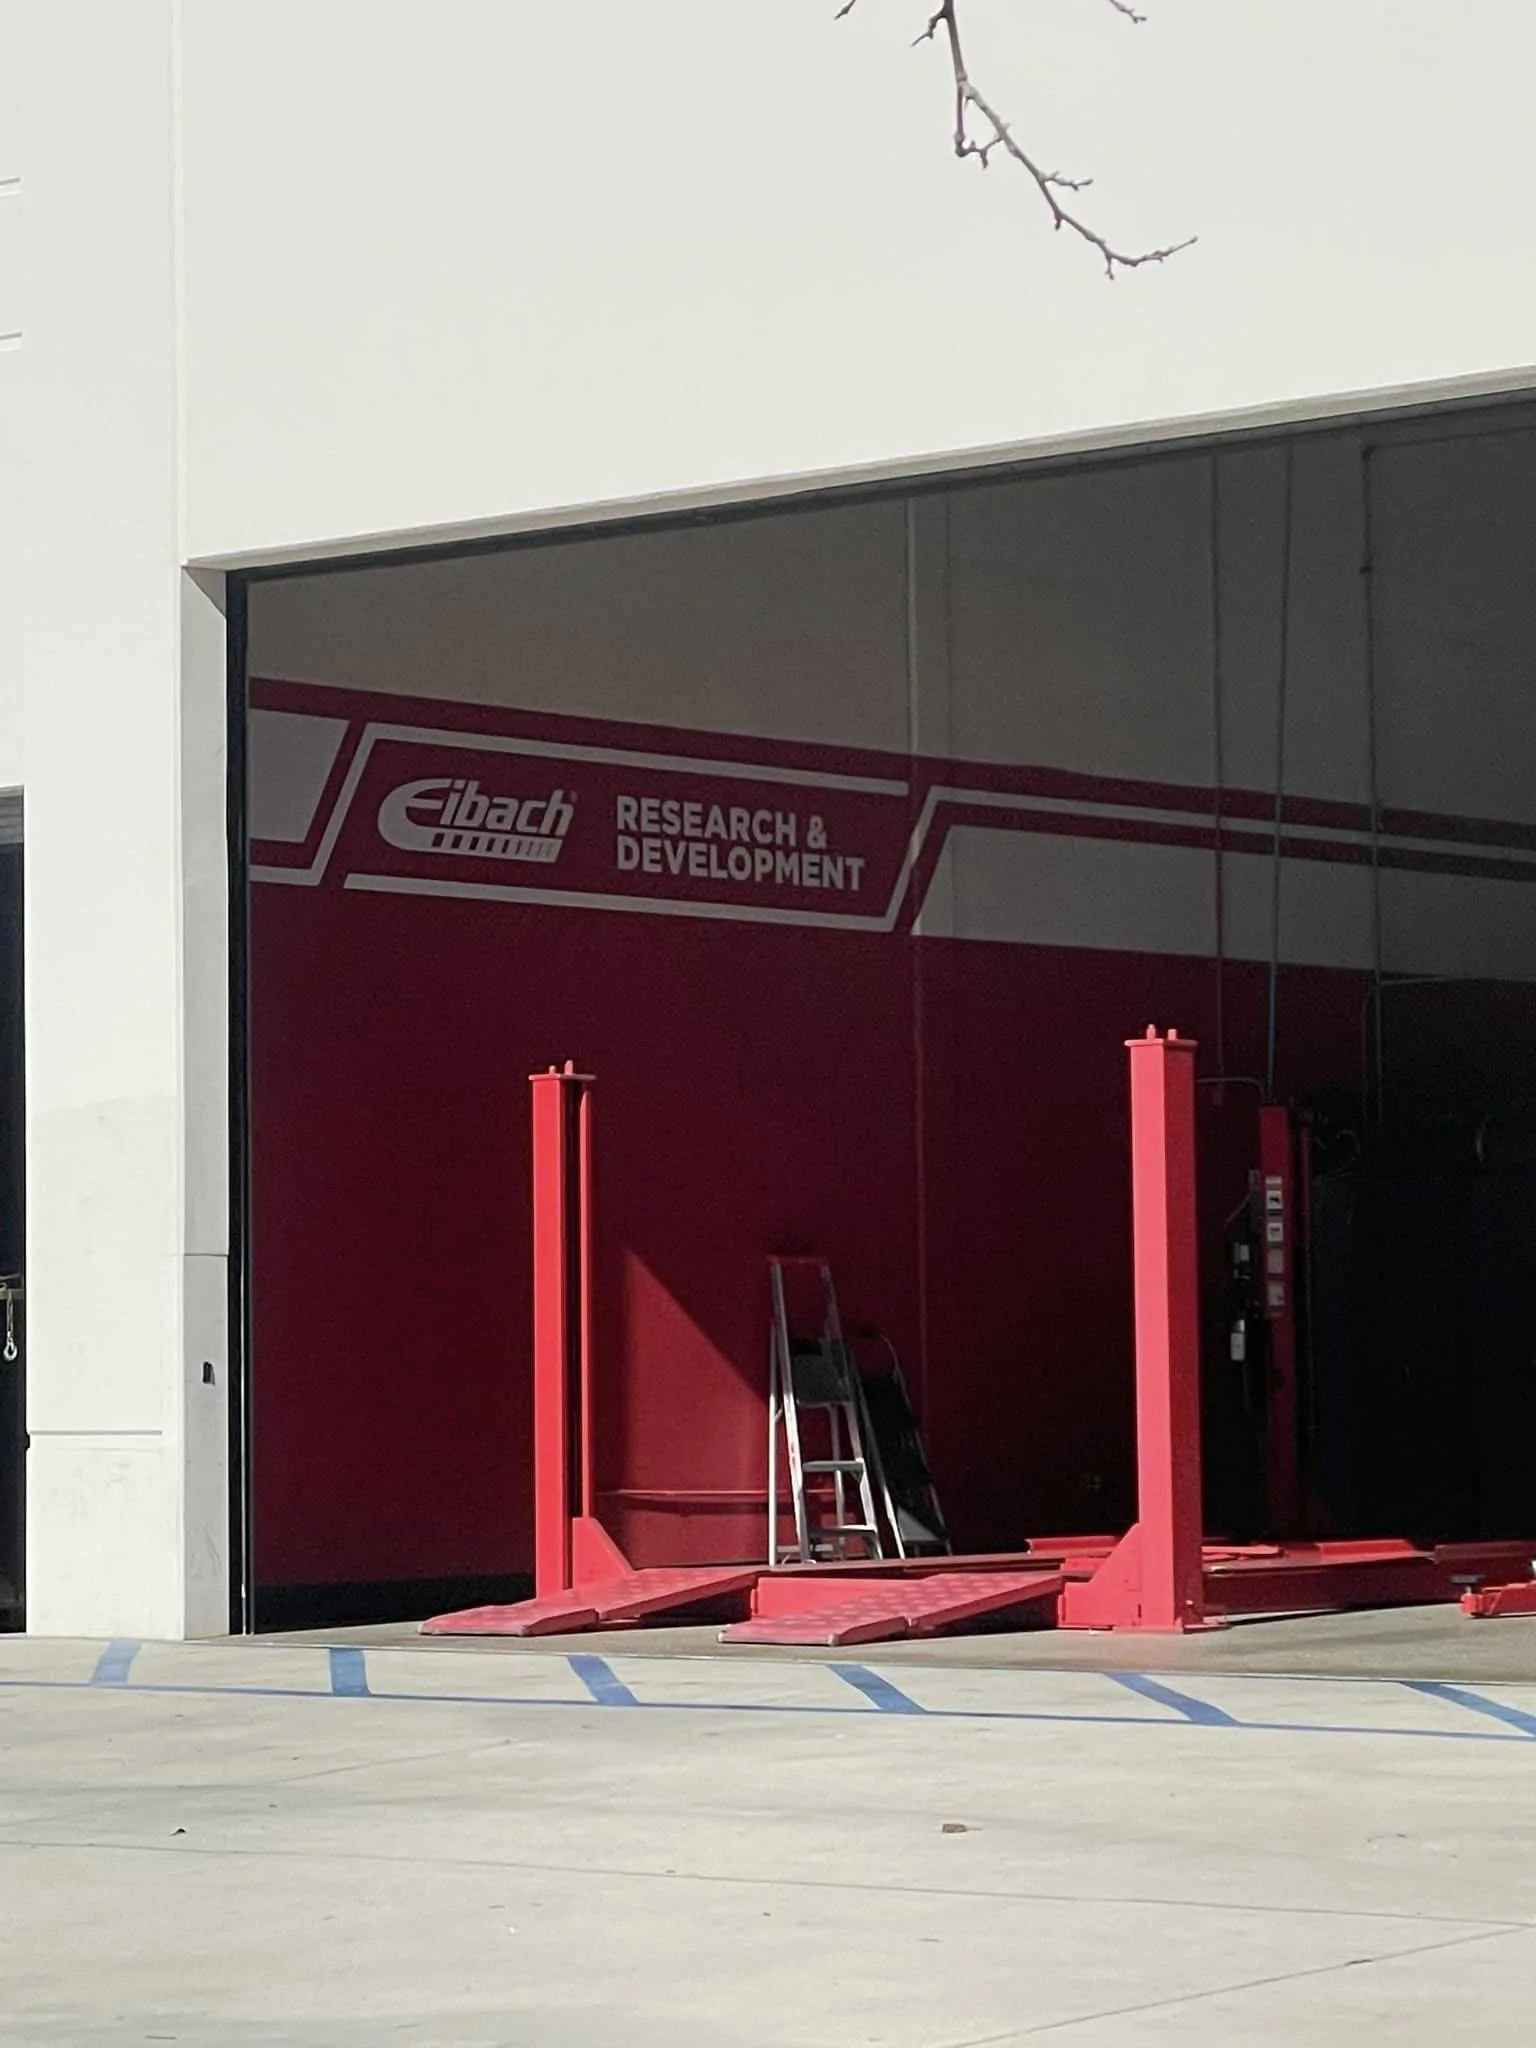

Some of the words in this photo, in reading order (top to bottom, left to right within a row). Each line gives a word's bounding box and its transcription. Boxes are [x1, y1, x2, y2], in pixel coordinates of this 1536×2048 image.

[377, 778, 574, 862] Eibach
[617, 796, 797, 846] RESEARCH
[806, 814, 828, 850] &
[617, 837, 865, 891] DEVELOPMENT
